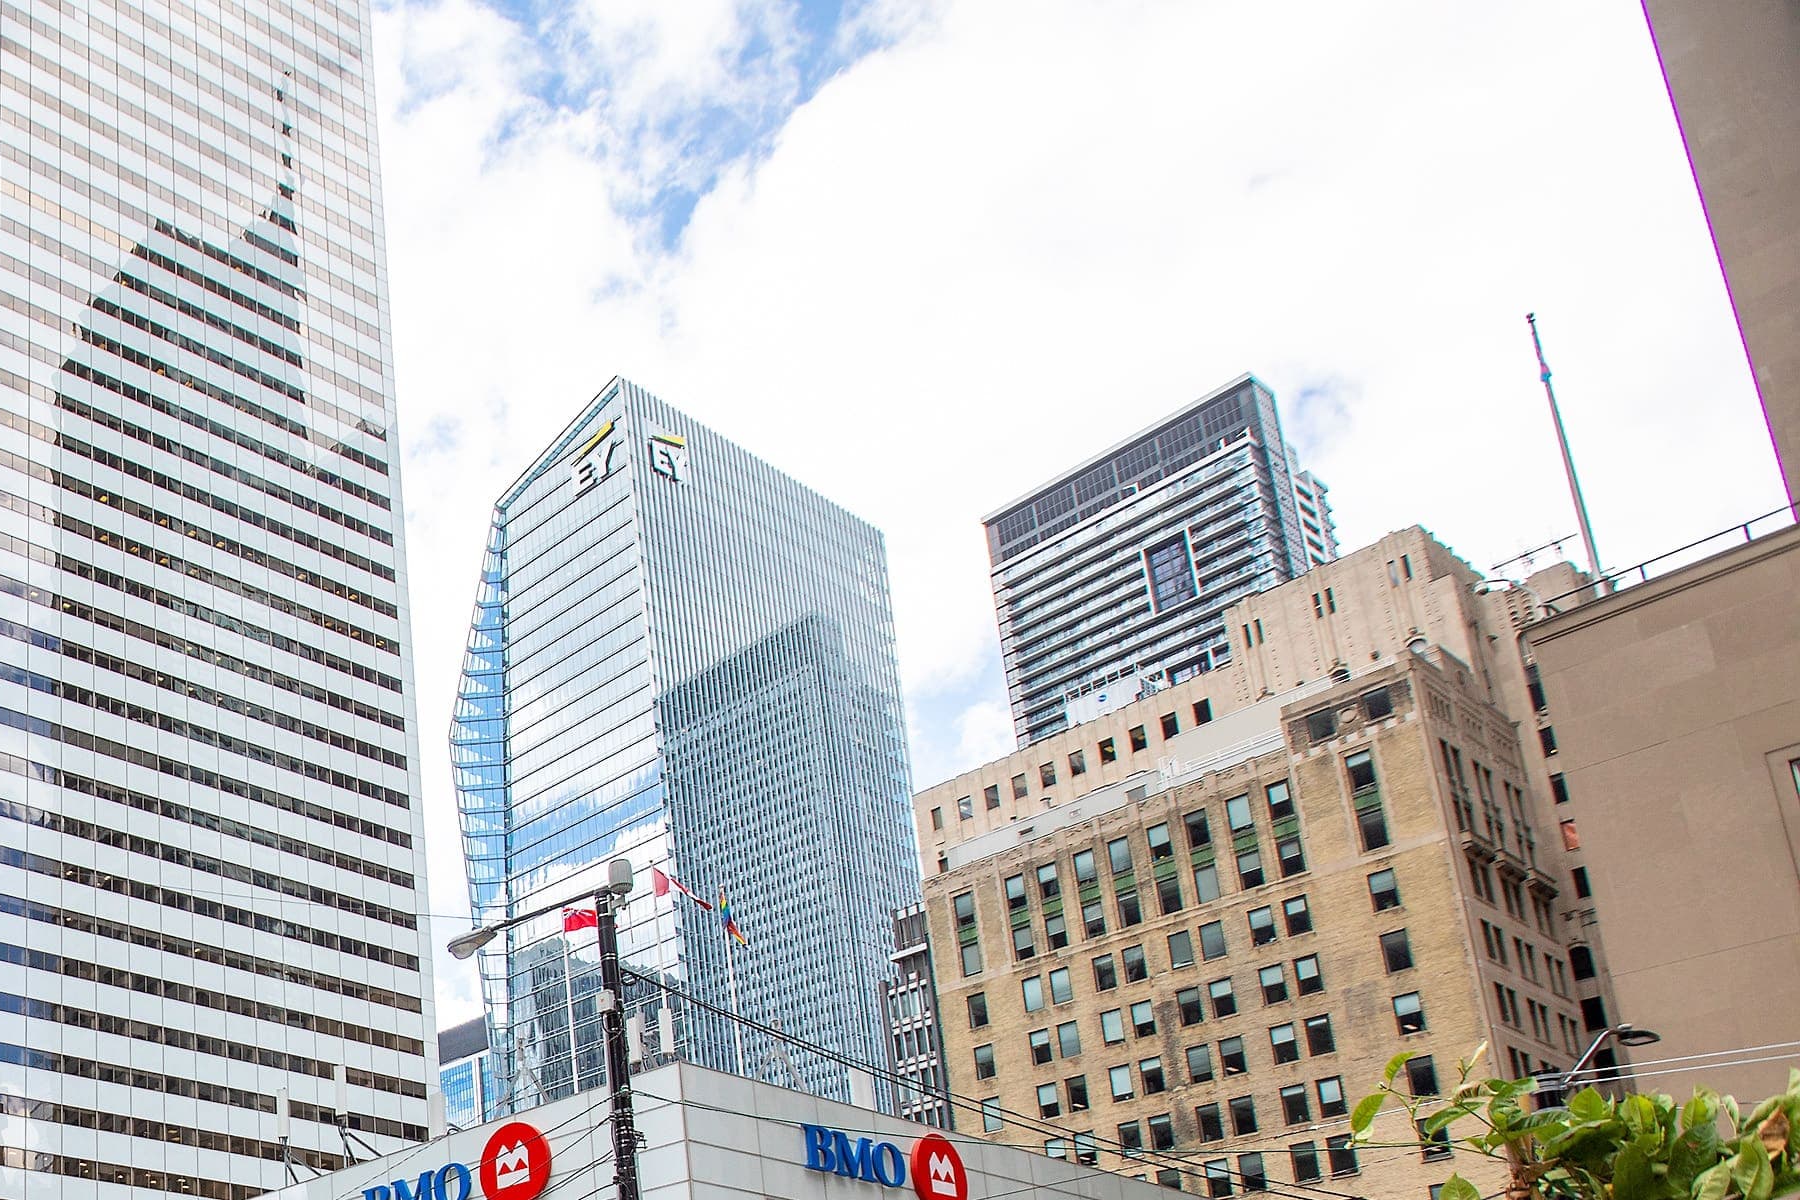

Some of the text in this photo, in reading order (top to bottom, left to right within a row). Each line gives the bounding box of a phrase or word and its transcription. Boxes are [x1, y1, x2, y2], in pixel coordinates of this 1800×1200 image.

[572, 440, 616, 497] EY
[648, 439, 687, 482] EY
[801, 1123, 906, 1188] BMO
